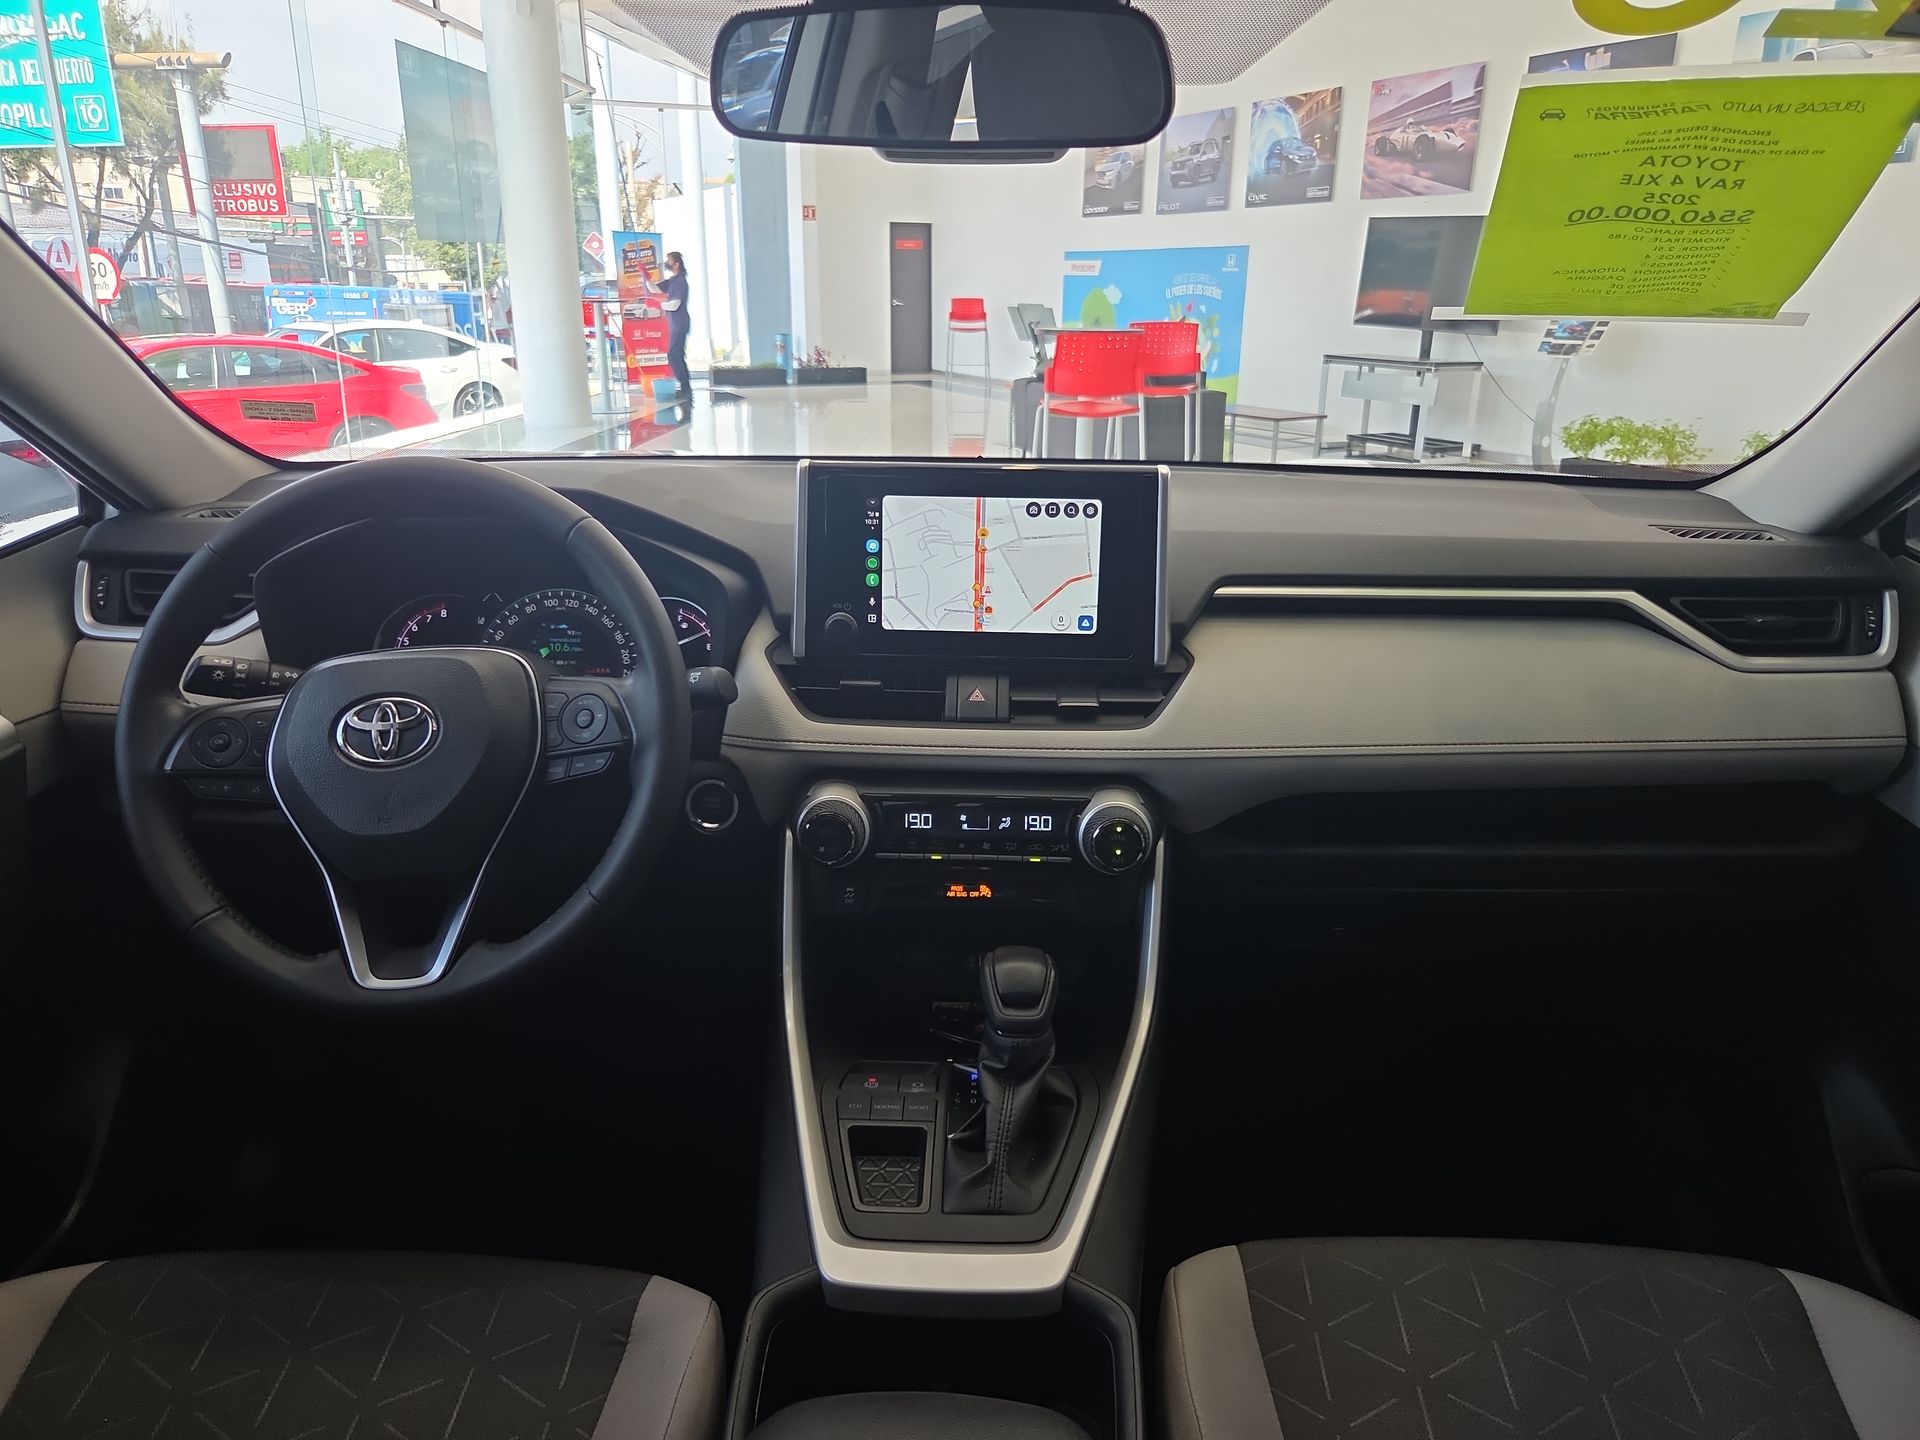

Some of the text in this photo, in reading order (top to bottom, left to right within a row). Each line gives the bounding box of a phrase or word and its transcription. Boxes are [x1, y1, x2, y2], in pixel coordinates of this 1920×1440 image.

[20, 59, 45, 86] DEL
[54, 57, 94, 84] UERTO
[80, 103, 103, 125] 10
[213, 198, 280, 213] ETROBUS
[1158, 203, 1181, 211] PILOT
[544, 598, 559, 607] 100
[565, 599, 580, 608] 120
[440, 609, 448, 618] 8
[525, 603, 537, 614] 80
[584, 604, 599, 616] 140
[426, 614, 432, 623] 7
[507, 614, 519, 626] 60
[601, 614, 615, 628] 160
[1058, 615, 1064, 624] 0
[411, 623, 419, 632] 6
[494, 630, 505, 641] 40
[613, 630, 626, 645] 180
[403, 637, 410, 646] 5
[550, 642, 570, 652] 10.6
[706, 643, 712, 651] E
[621, 648, 631, 665] 200
[904, 813, 932, 829] 19.0
[1024, 815, 1052, 831] 19.0
